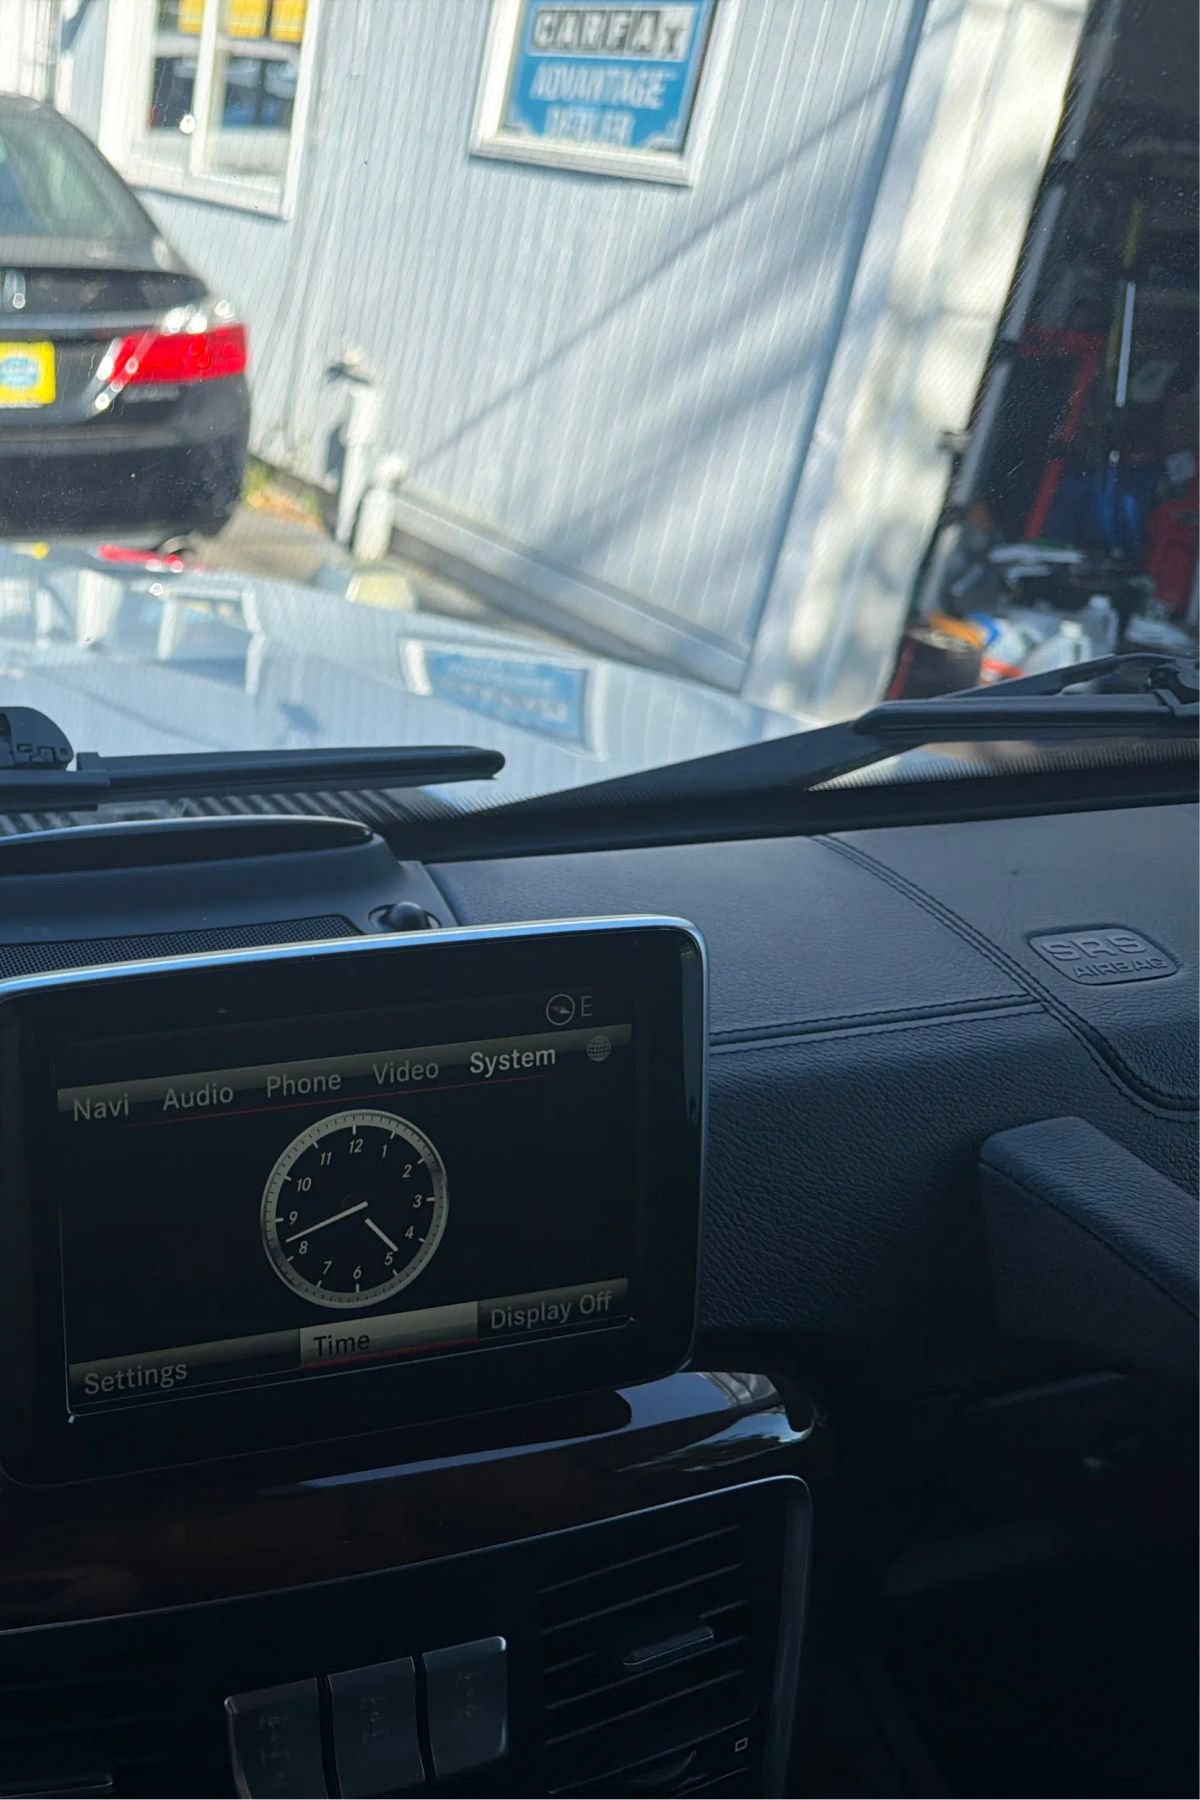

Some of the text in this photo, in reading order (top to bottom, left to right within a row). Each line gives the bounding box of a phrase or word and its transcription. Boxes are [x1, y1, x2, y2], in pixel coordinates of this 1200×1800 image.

[533, 9, 688, 54] CARFAX
[529, 63, 677, 110] ADVANTAGE
[1041, 935, 1147, 961] SRS
[1072, 957, 1167, 978] AIRBAG
[580, 995, 593, 1017] E
[73, 1048, 556, 1122] Navi Audio Phone Video System
[349, 1138, 364, 1154] 12
[320, 1151, 332, 1166] 11
[402, 1163, 412, 1178] 2
[296, 1177, 312, 1192] 10
[412, 1194, 422, 1208] 3
[288, 1211, 298, 1225] 9
[404, 1225, 414, 1239] 4
[299, 1240, 308, 1255] 8
[384, 1252, 394, 1266] 5
[322, 1260, 332, 1275] 7
[352, 1265, 362, 1280] 6
[491, 1290, 613, 1330] Display Off
[313, 1333, 371, 1357] Time
[84, 1362, 188, 1395] Settings
